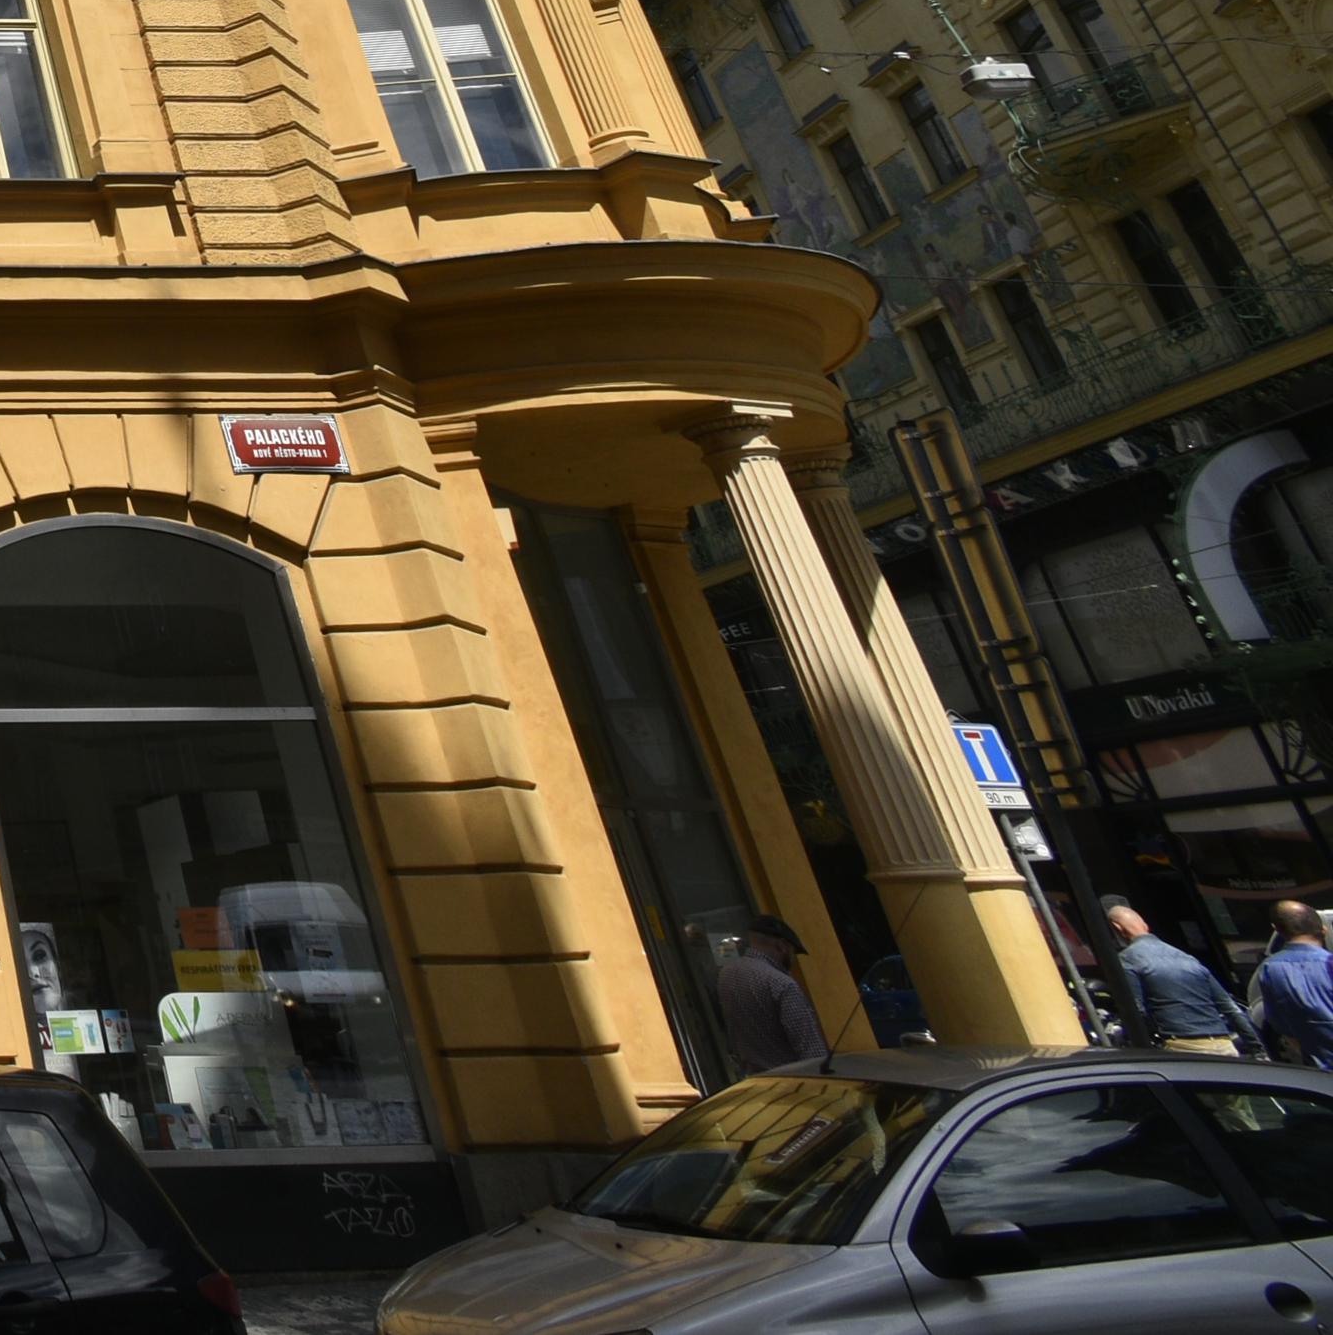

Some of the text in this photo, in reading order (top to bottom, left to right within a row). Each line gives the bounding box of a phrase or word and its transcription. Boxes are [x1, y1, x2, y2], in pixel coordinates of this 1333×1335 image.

[244, 426, 326, 446] PALACKÉHO
[253, 446, 272, 458] NOVÉ
[322, 449, 328, 459] 1
[985, 792, 1017, 804] 90 m
